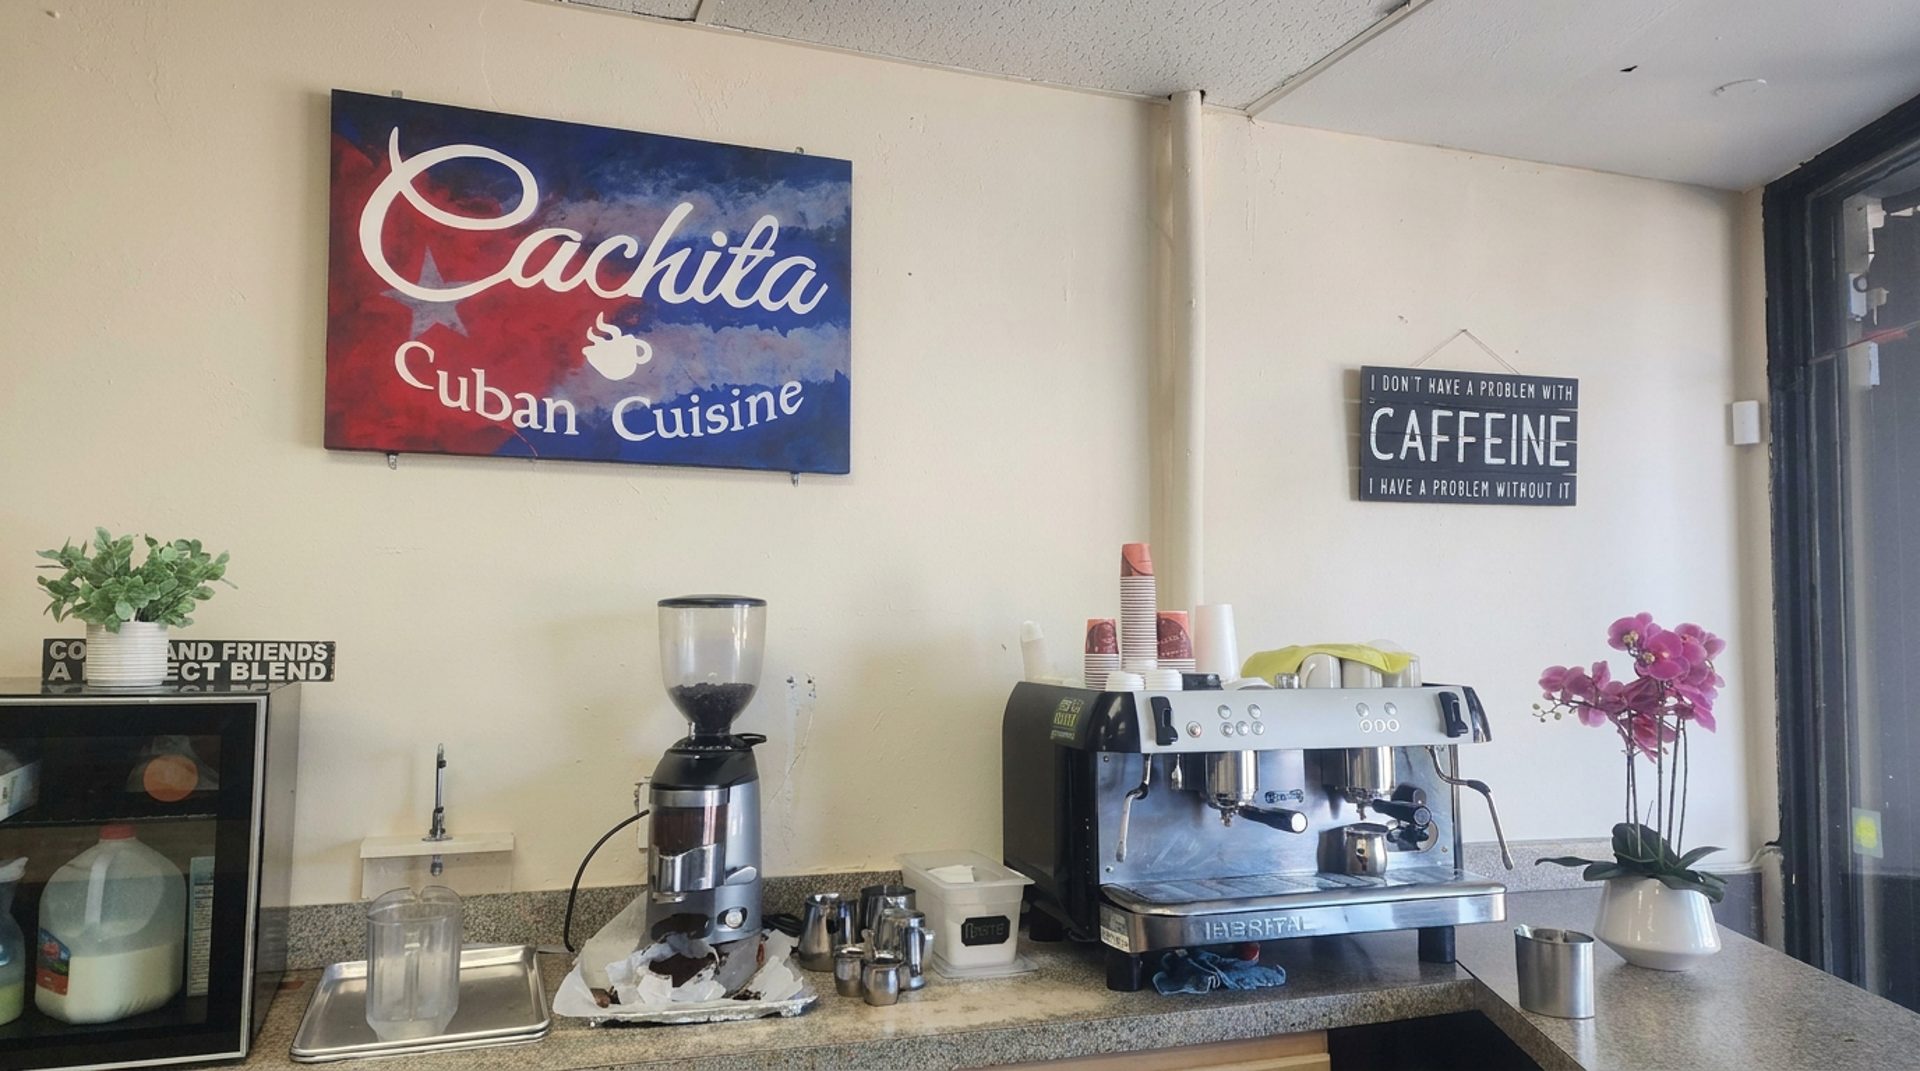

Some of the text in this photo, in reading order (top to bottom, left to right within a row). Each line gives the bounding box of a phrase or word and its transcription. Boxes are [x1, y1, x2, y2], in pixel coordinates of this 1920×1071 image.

[359, 126, 829, 315] Cachita
[395, 341, 804, 441] Cuban Cuisine
[1370, 374, 1573, 401] I DON'T HAVE A PROBLEM WITH
[1369, 407, 1571, 467] CAFFEINE
[1369, 477, 1571, 499] I HAVE A PROBLEM WITHOUT IT
[167, 642, 328, 662] AND FRIENDS
[48, 661, 71, 681] A
[230, 662, 327, 681] BLEND
